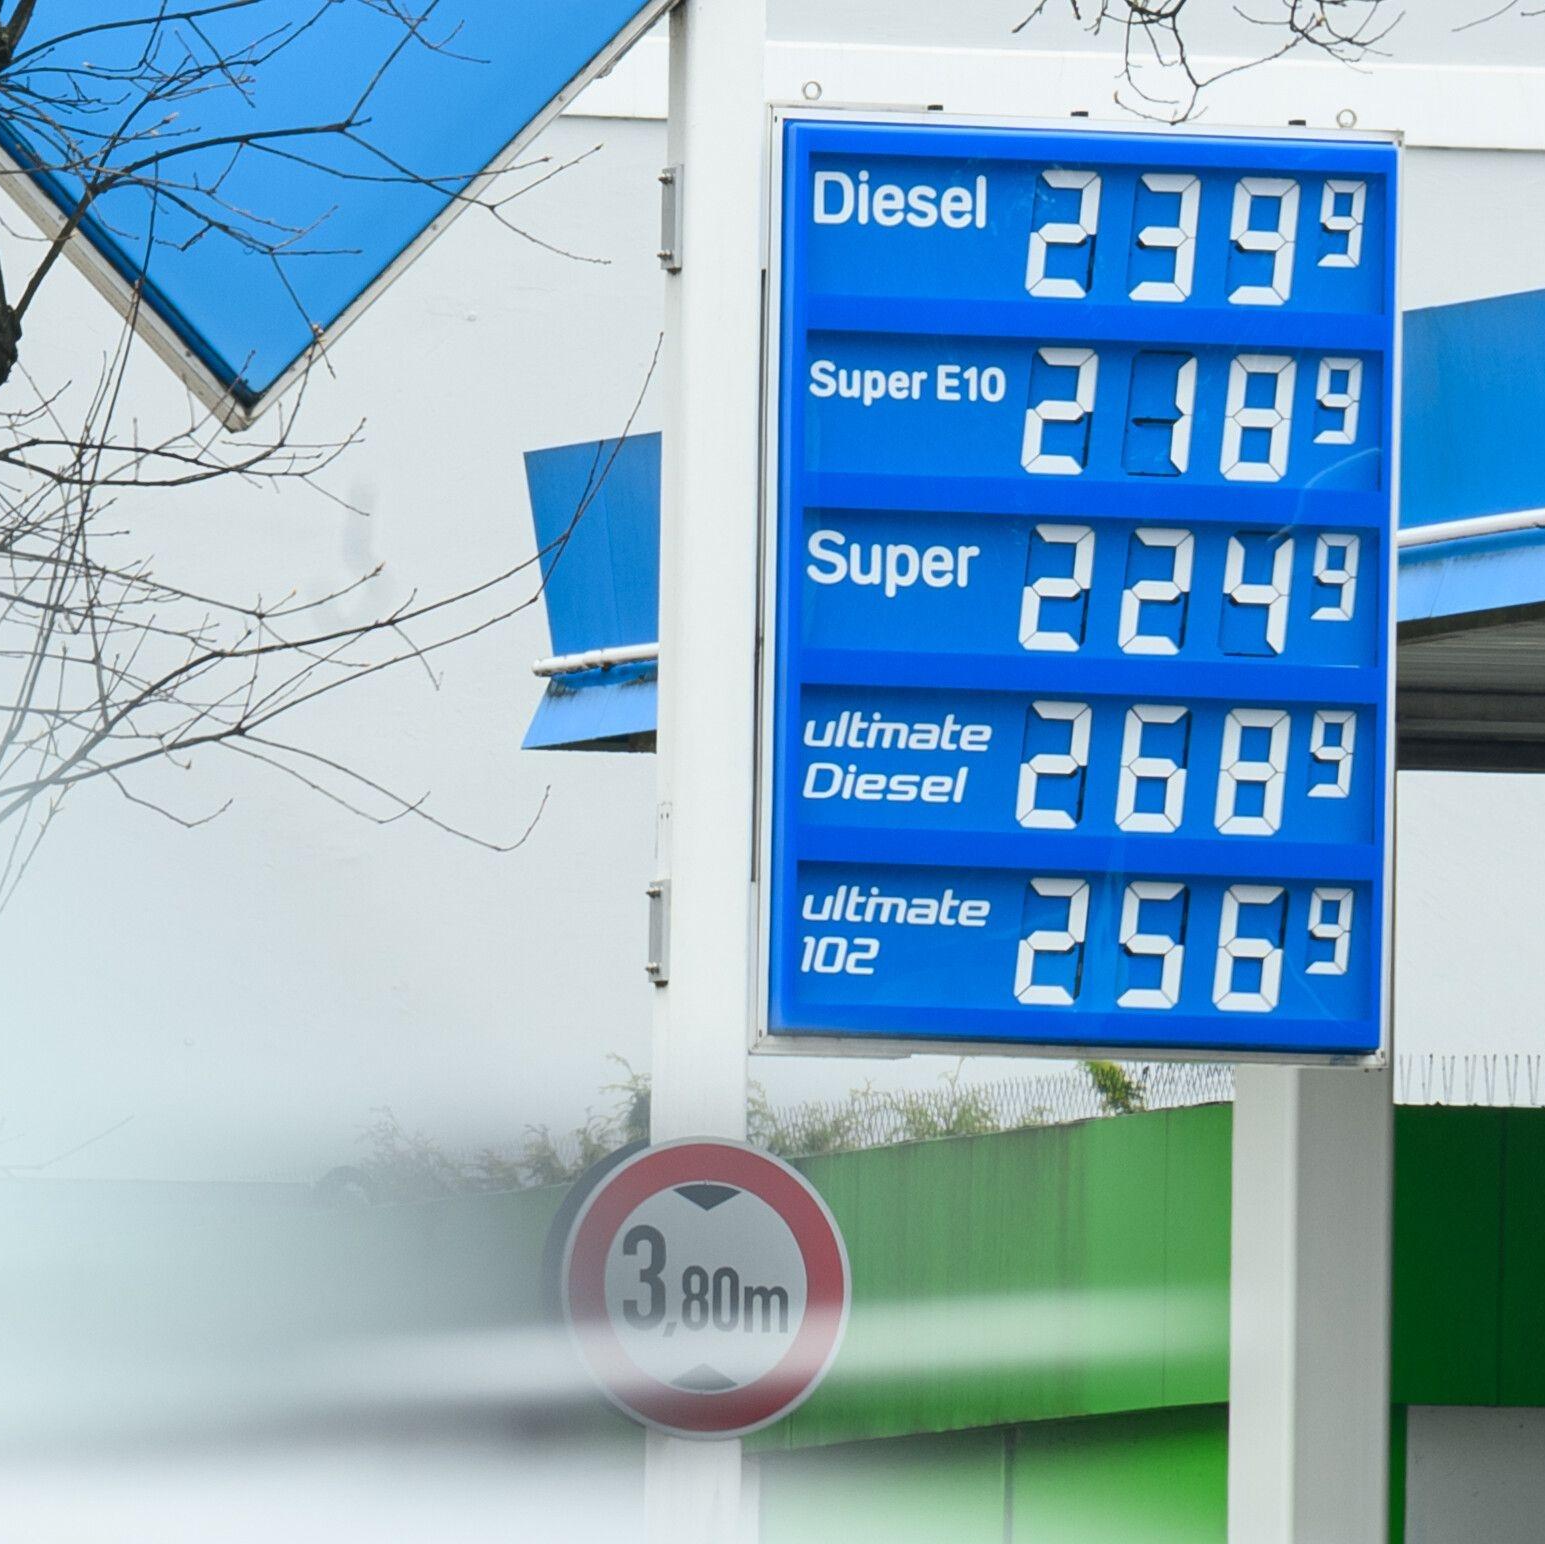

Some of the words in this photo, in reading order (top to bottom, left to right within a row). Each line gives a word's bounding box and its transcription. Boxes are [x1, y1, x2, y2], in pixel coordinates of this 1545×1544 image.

[813, 170, 987, 229] Diesel
[808, 359, 929, 407] Super
[936, 364, 1007, 403] E10
[806, 528, 981, 599] Super
[802, 711, 993, 753] ultimate
[802, 762, 969, 804] Diesel
[801, 885, 991, 927] ultimate
[800, 935, 880, 976] 102
[621, 1224, 790, 1338] 3,80m
